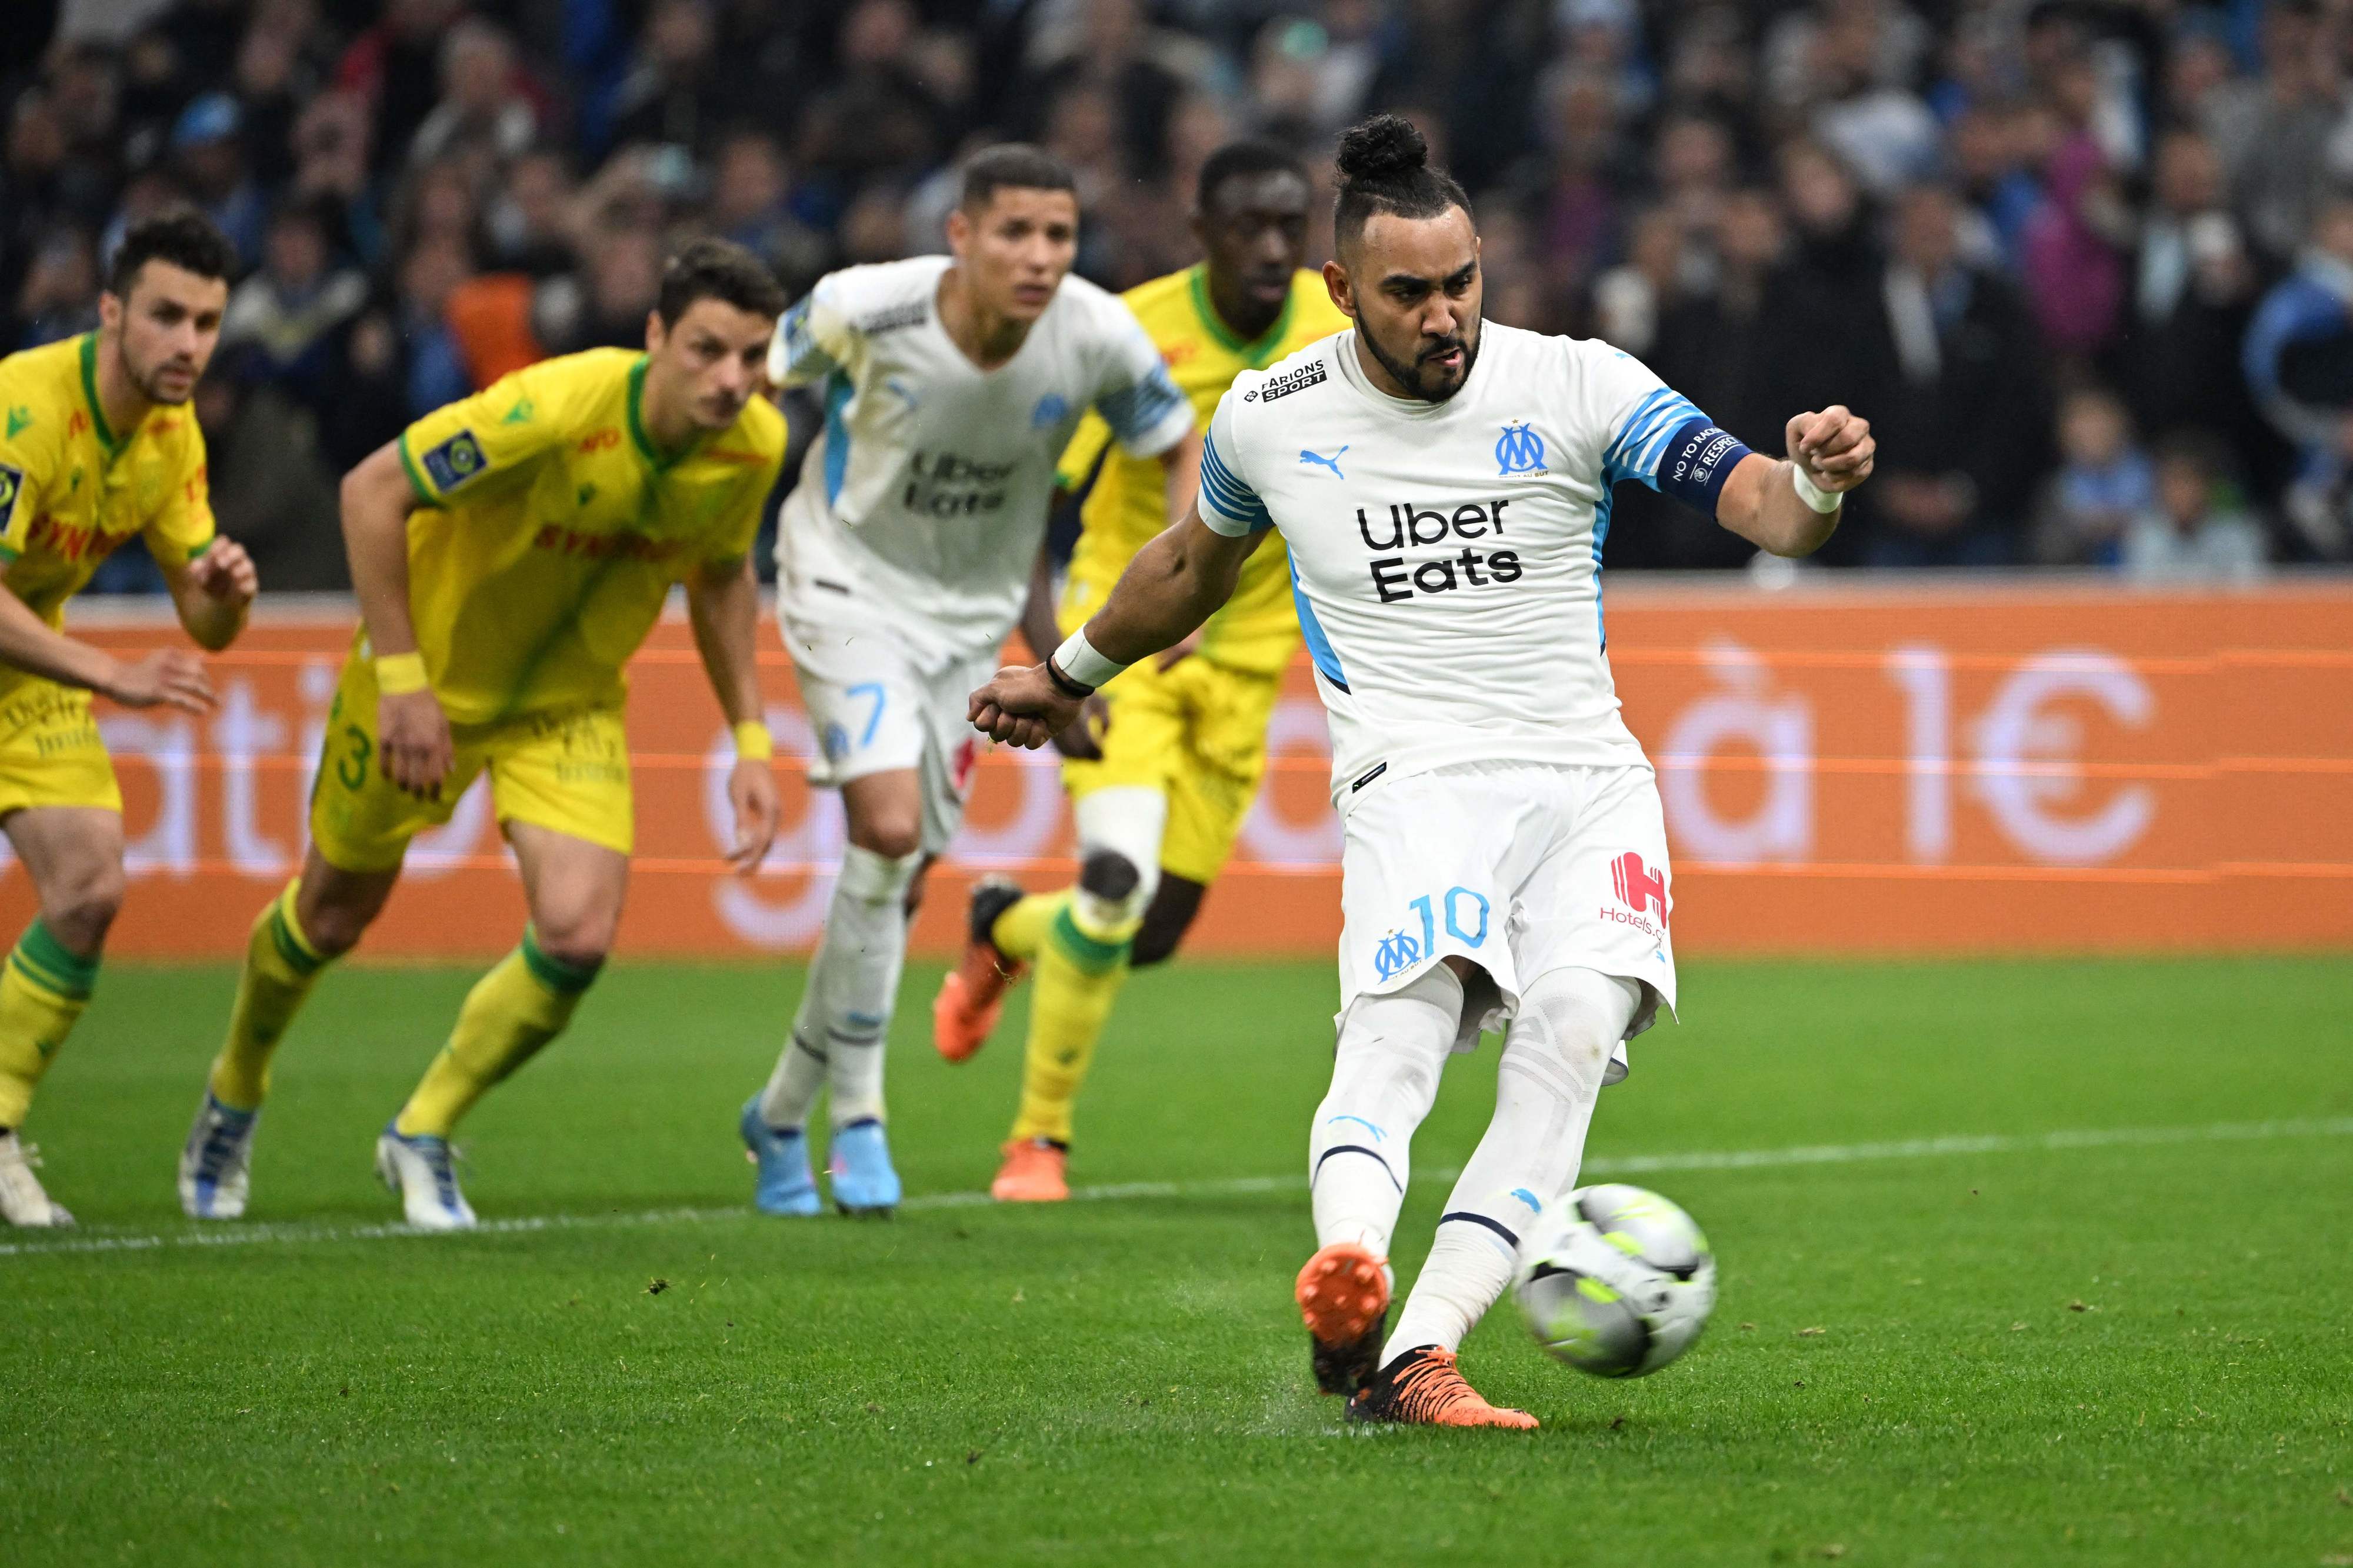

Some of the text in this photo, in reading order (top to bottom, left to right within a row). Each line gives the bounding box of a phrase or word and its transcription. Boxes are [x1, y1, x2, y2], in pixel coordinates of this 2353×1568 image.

[1265, 372, 1324, 401] SPORT
[1672, 461, 1687, 482] NO
[1682, 443, 1698, 459] TO
[1702, 436, 1739, 466] RESPECT
[1357, 499, 1509, 551] Uber
[1369, 548, 1522, 603] Eats
[845, 680, 887, 748] 7
[1657, 635, 1815, 868] à
[1409, 886, 1490, 960] 10
[1600, 907, 1665, 945] Hotels.c
